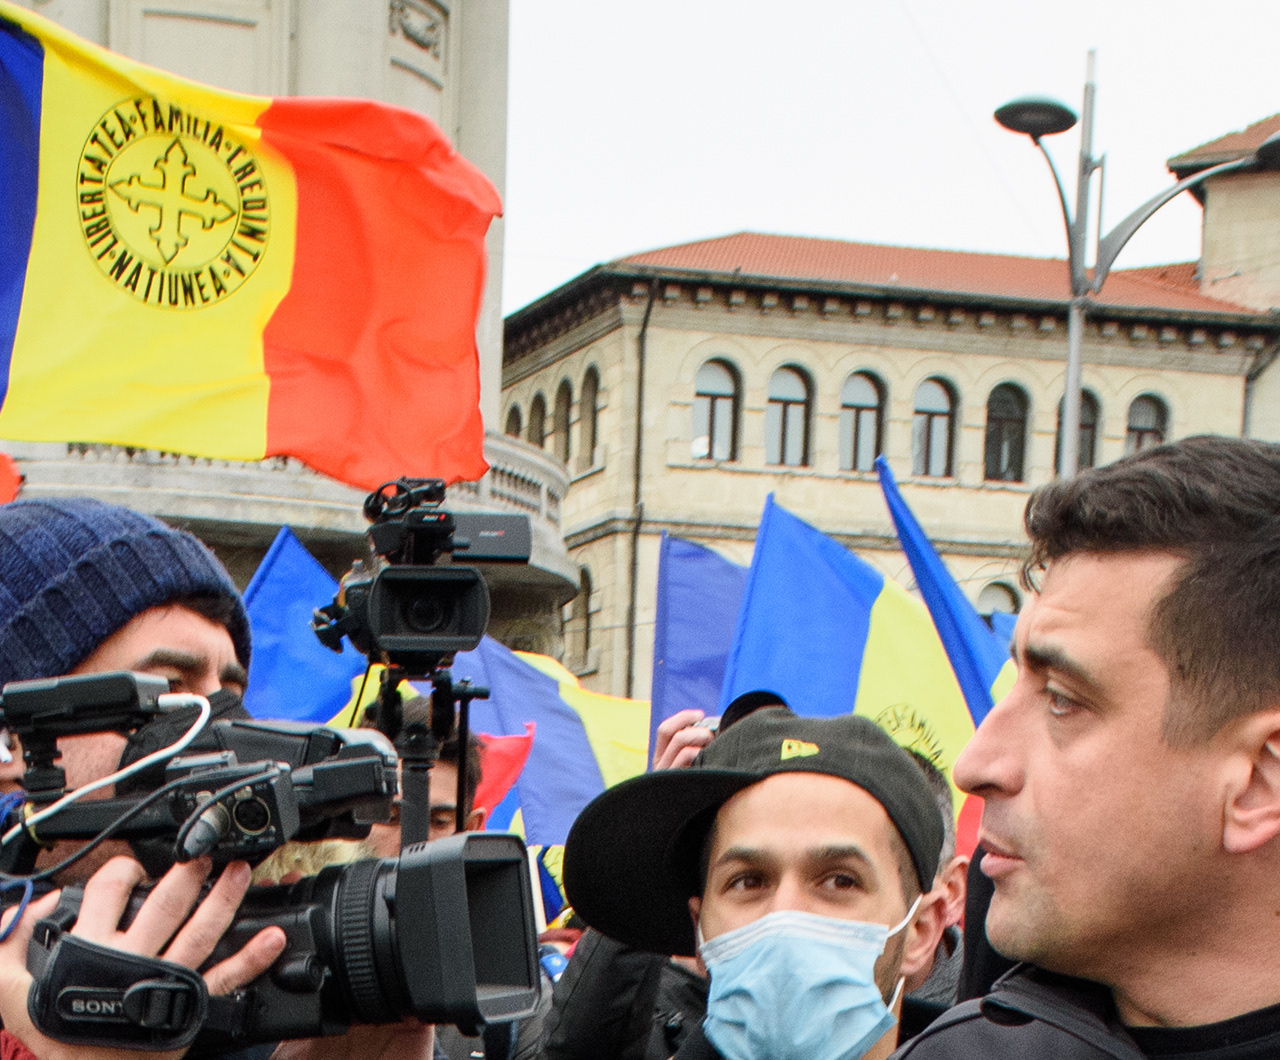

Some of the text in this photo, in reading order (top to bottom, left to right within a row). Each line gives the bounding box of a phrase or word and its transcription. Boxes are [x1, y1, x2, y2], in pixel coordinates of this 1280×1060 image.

[132, 98, 224, 153] FAMILIA
[79, 109, 137, 261] LIBERTATEA
[109, 248, 227, 307] NATIUNEA
